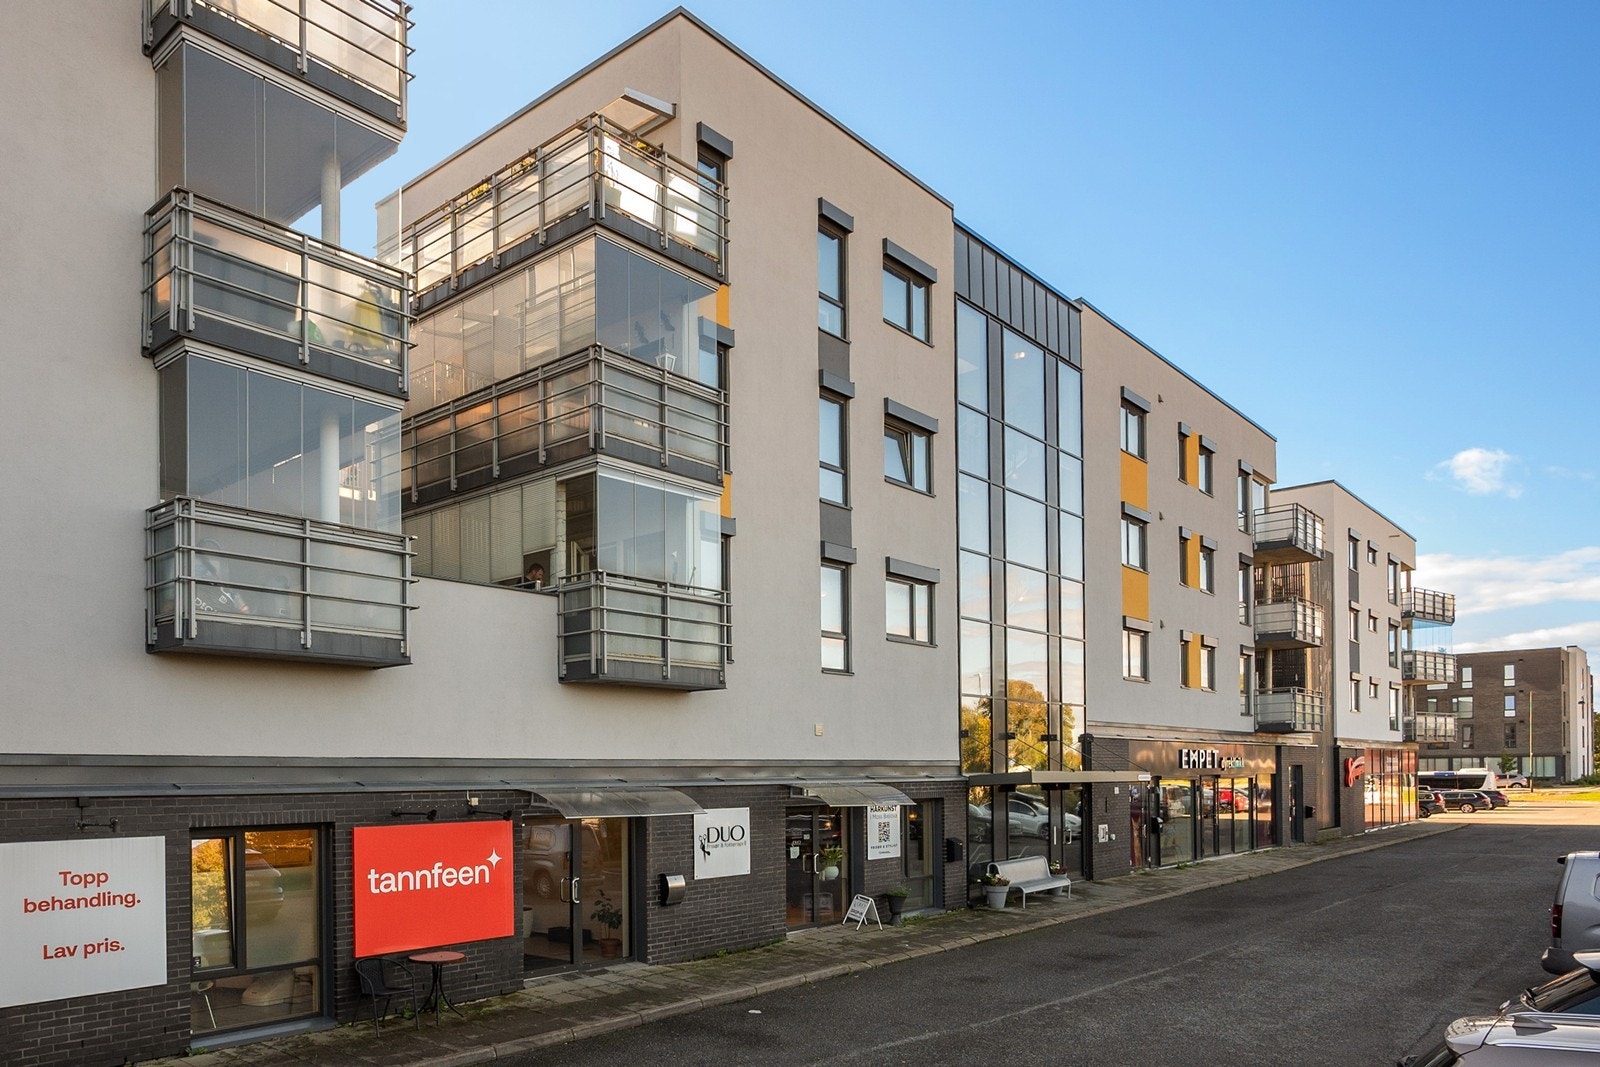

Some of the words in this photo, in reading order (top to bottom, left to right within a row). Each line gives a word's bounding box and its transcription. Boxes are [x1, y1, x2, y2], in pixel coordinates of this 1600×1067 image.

[1181, 749, 1219, 769] EMPET
[707, 825, 745, 843] DUO
[59, 871, 109, 888] Topp
[367, 862, 490, 894] tannfeen
[23, 891, 141, 913] behandling.
[43, 944, 78, 960] Lav
[83, 938, 125, 959] pris.
